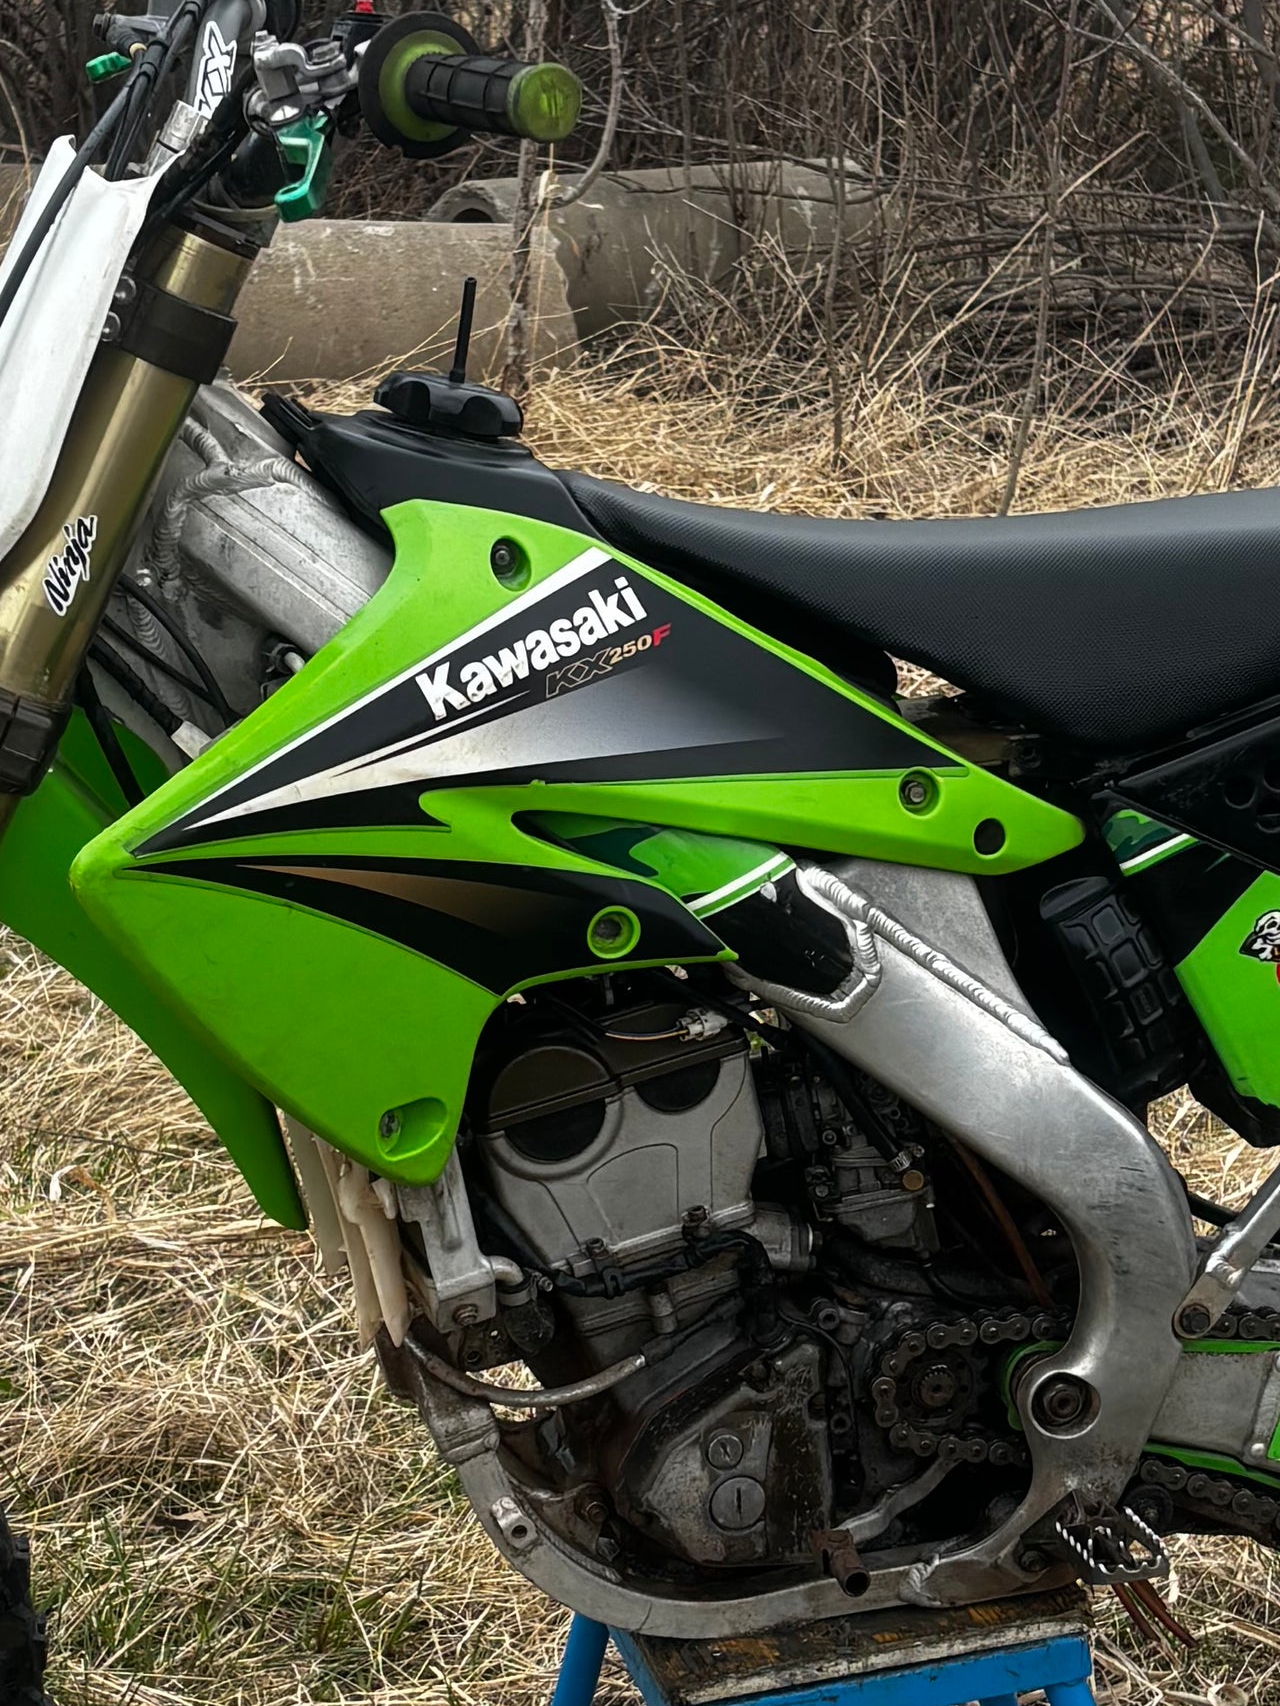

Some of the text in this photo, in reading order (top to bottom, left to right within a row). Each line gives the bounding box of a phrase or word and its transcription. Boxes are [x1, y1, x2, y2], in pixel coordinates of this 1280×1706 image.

[42, 514, 98, 616] Ninja
[415, 576, 648, 721] Kawasaki
[545, 623, 671, 698] KX250F
